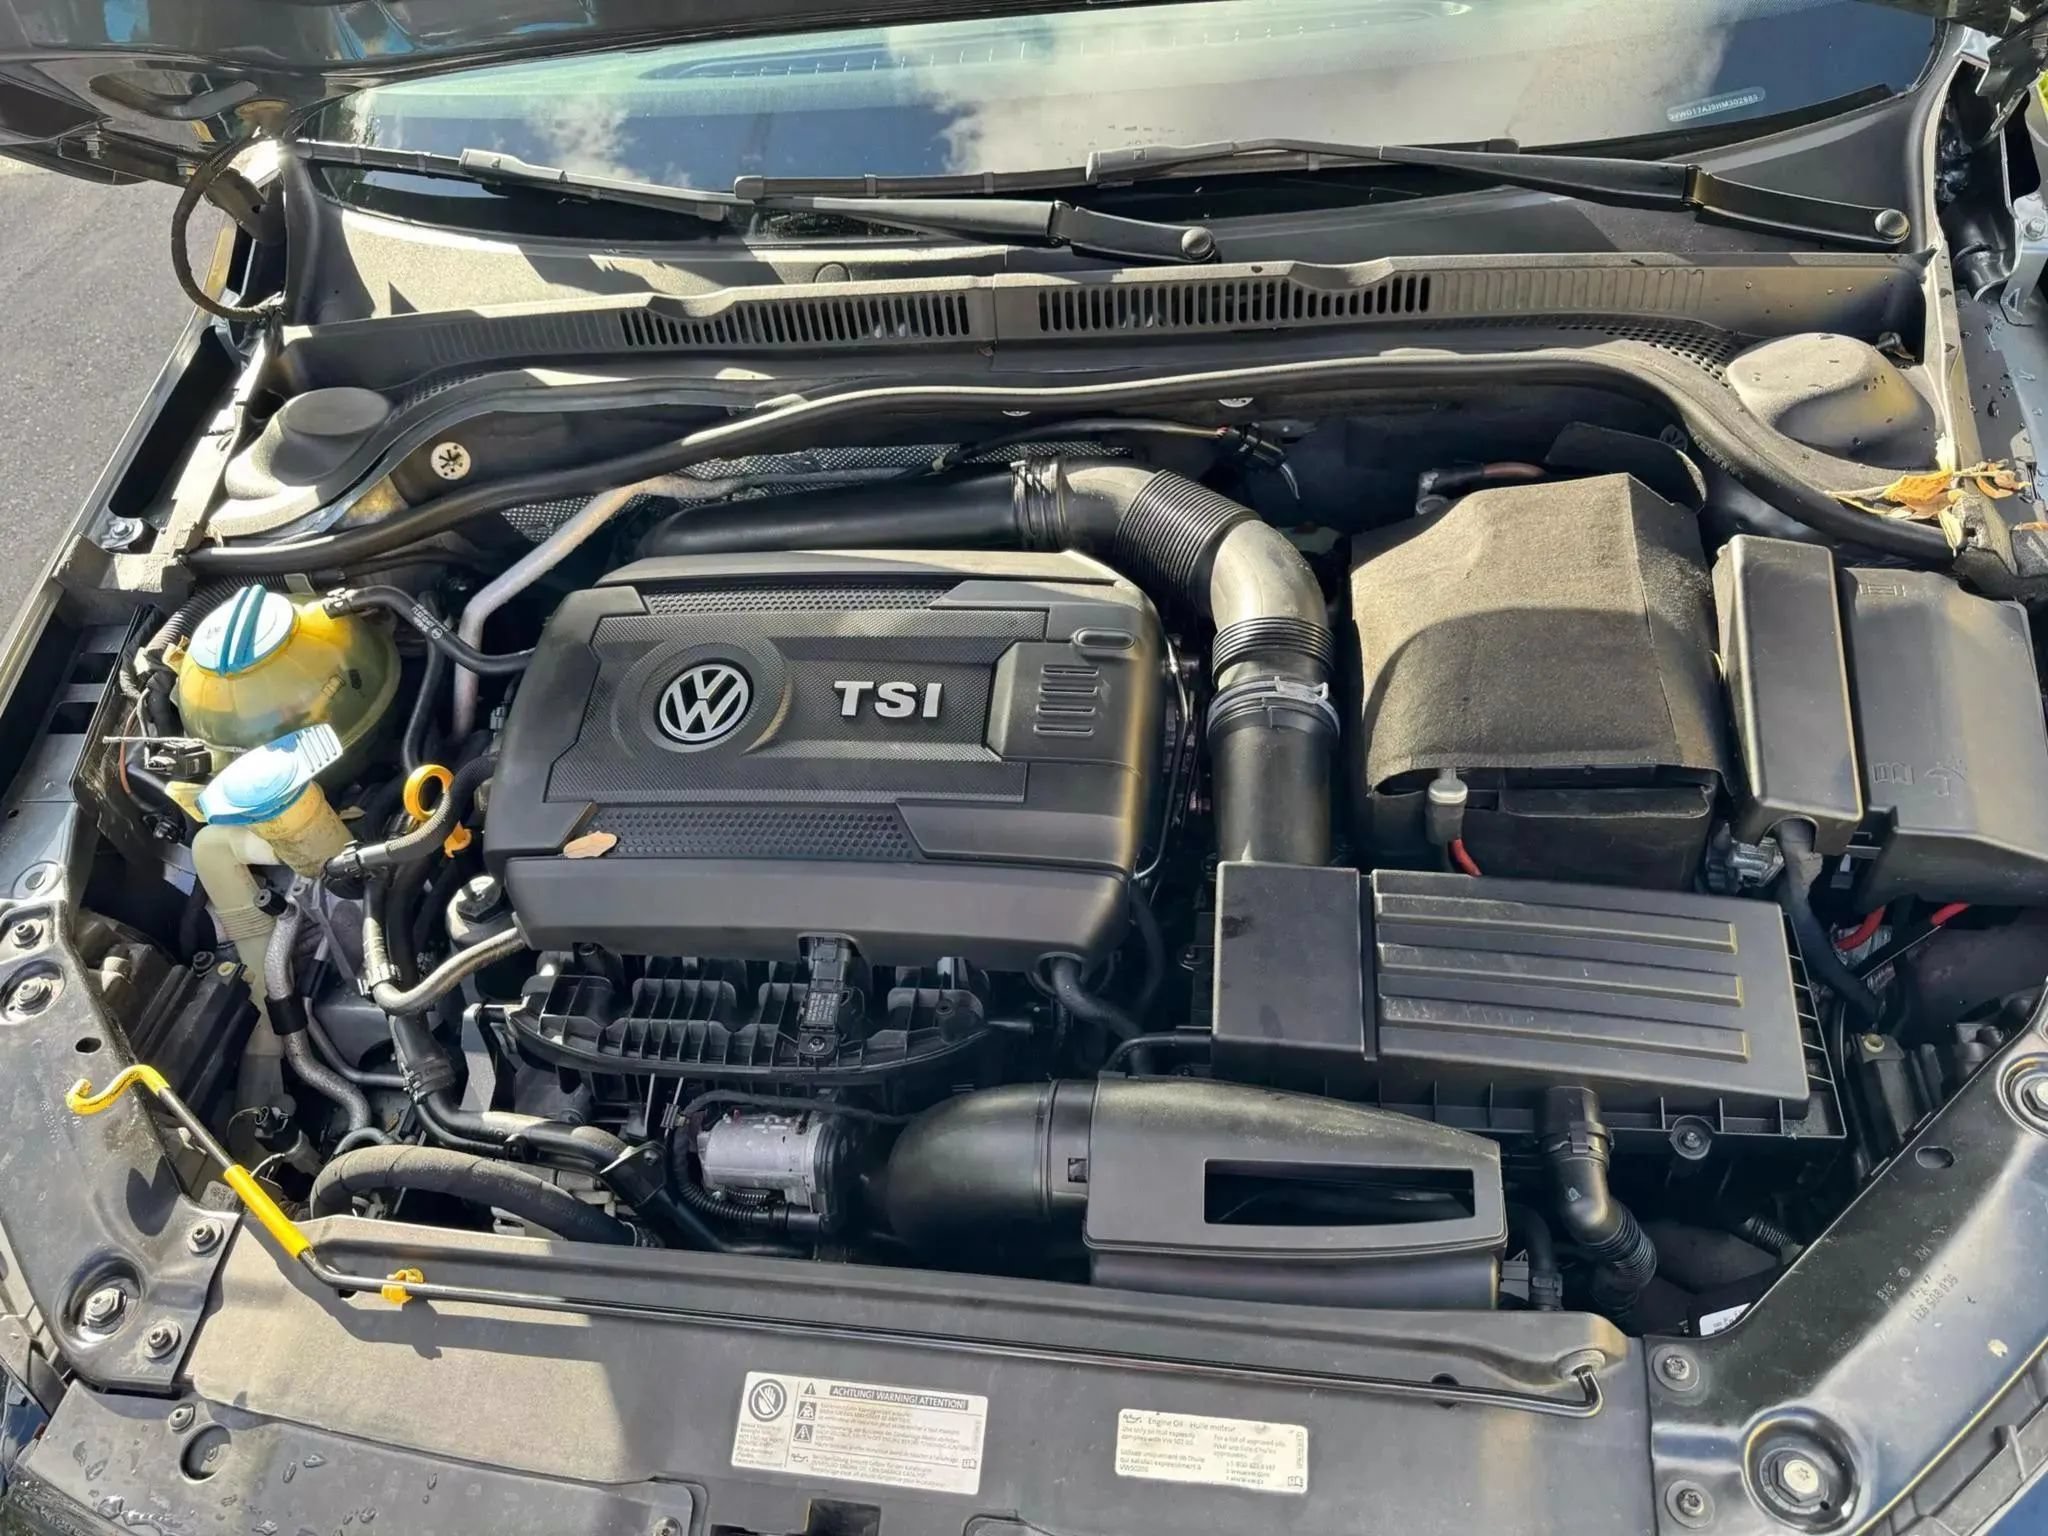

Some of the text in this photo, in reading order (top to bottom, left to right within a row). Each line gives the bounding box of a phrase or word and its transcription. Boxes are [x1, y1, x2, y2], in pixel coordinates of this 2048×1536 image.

[833, 680, 944, 719] TSI
[832, 1387, 967, 1409] ACHTUNG! WARNING! ATTENTION!
